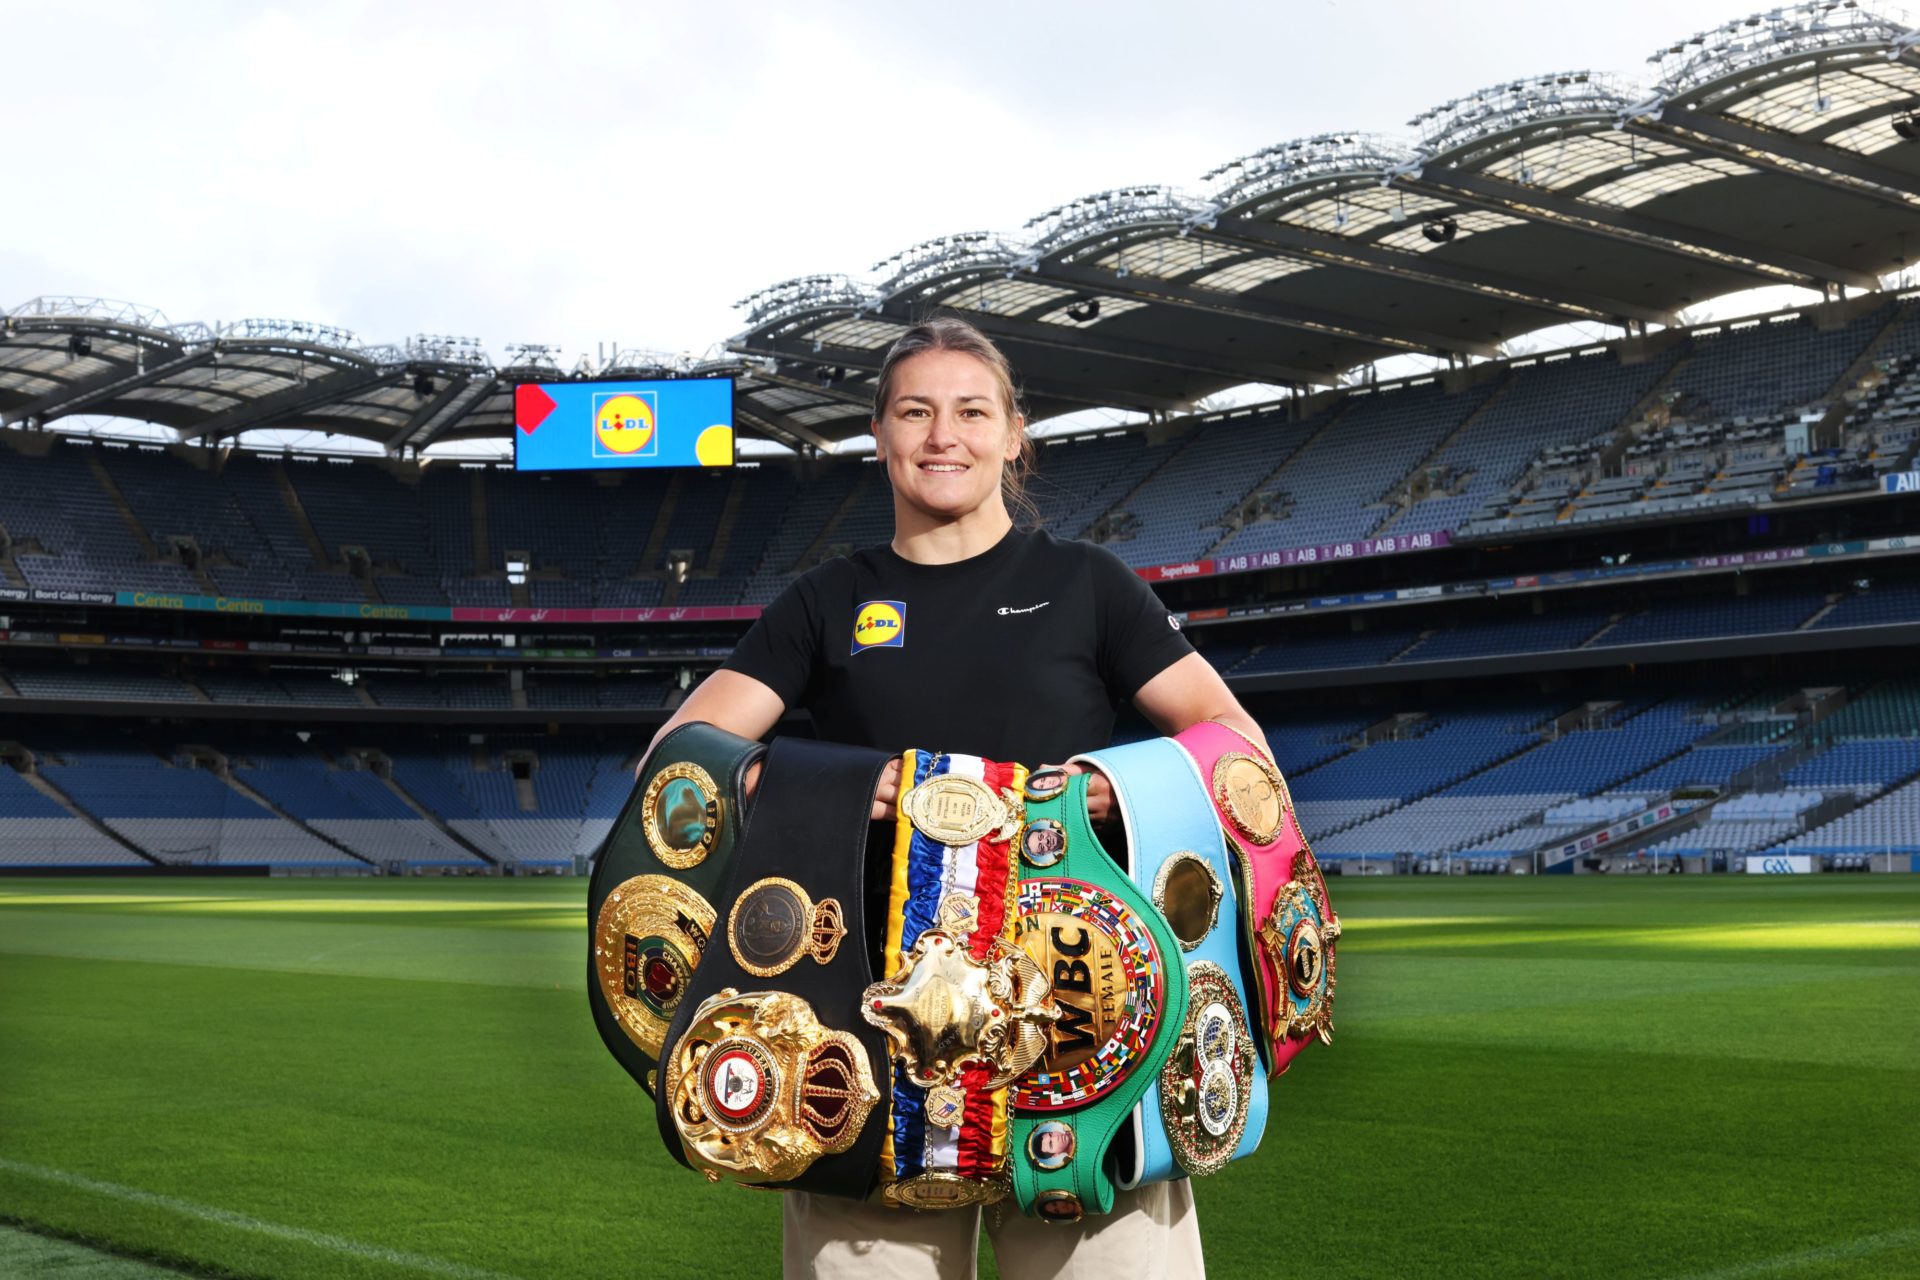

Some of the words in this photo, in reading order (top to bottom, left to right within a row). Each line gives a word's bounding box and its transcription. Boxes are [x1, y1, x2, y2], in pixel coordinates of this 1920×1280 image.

[1375, 538, 1396, 552] AIB
[1411, 533, 1432, 547] AIB
[1297, 548, 1317, 561] AIB
[1334, 544, 1354, 558] AIB
[1229, 557, 1248, 570] AIB
[1261, 553, 1281, 566] AIB
[1160, 563, 1199, 578] SuperValu
[35, 590, 58, 600] Bord
[81, 592, 114, 604] Energy
[134, 592, 184, 609] Centra
[215, 596, 264, 613] Centra
[360, 603, 408, 620] Centra
[997, 601, 1050, 615] Champion
[626, 942, 637, 991] IBO
[1051, 926, 1095, 1053] WBC
[1100, 949, 1114, 1023] FEMALE
[742, 1044, 769, 1070] SUPER
